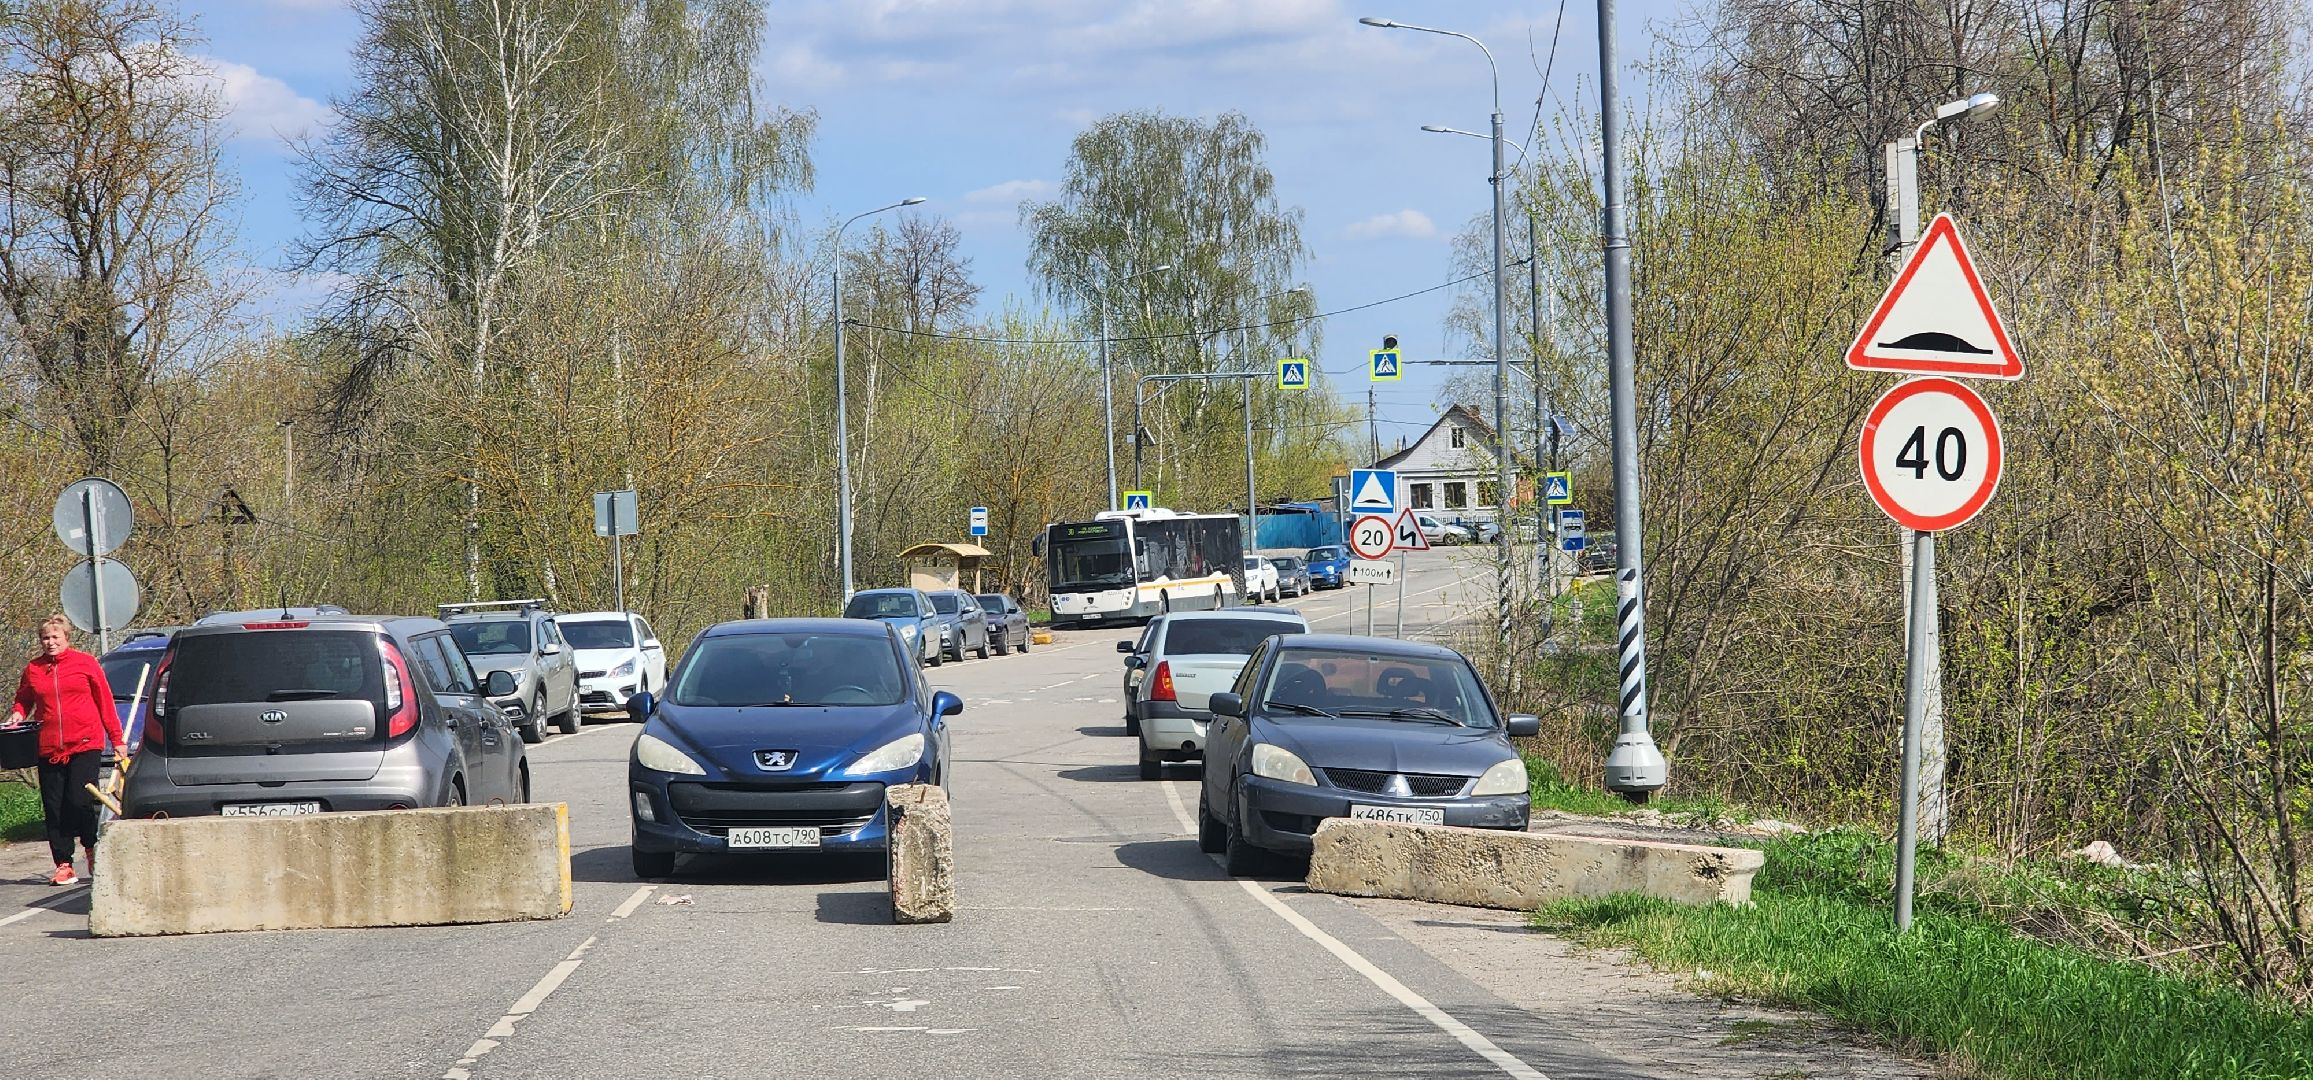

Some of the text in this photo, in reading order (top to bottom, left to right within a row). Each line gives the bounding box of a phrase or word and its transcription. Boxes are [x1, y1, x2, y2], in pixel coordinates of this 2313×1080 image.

[1895, 425, 1967, 482] 40
[1361, 529, 1384, 546] 20
[263, 711, 283, 722] KIA
[292, 803, 315, 815] 750
[1418, 809, 1440, 821] 750
[733, 829, 816, 844] А608ТС 790
